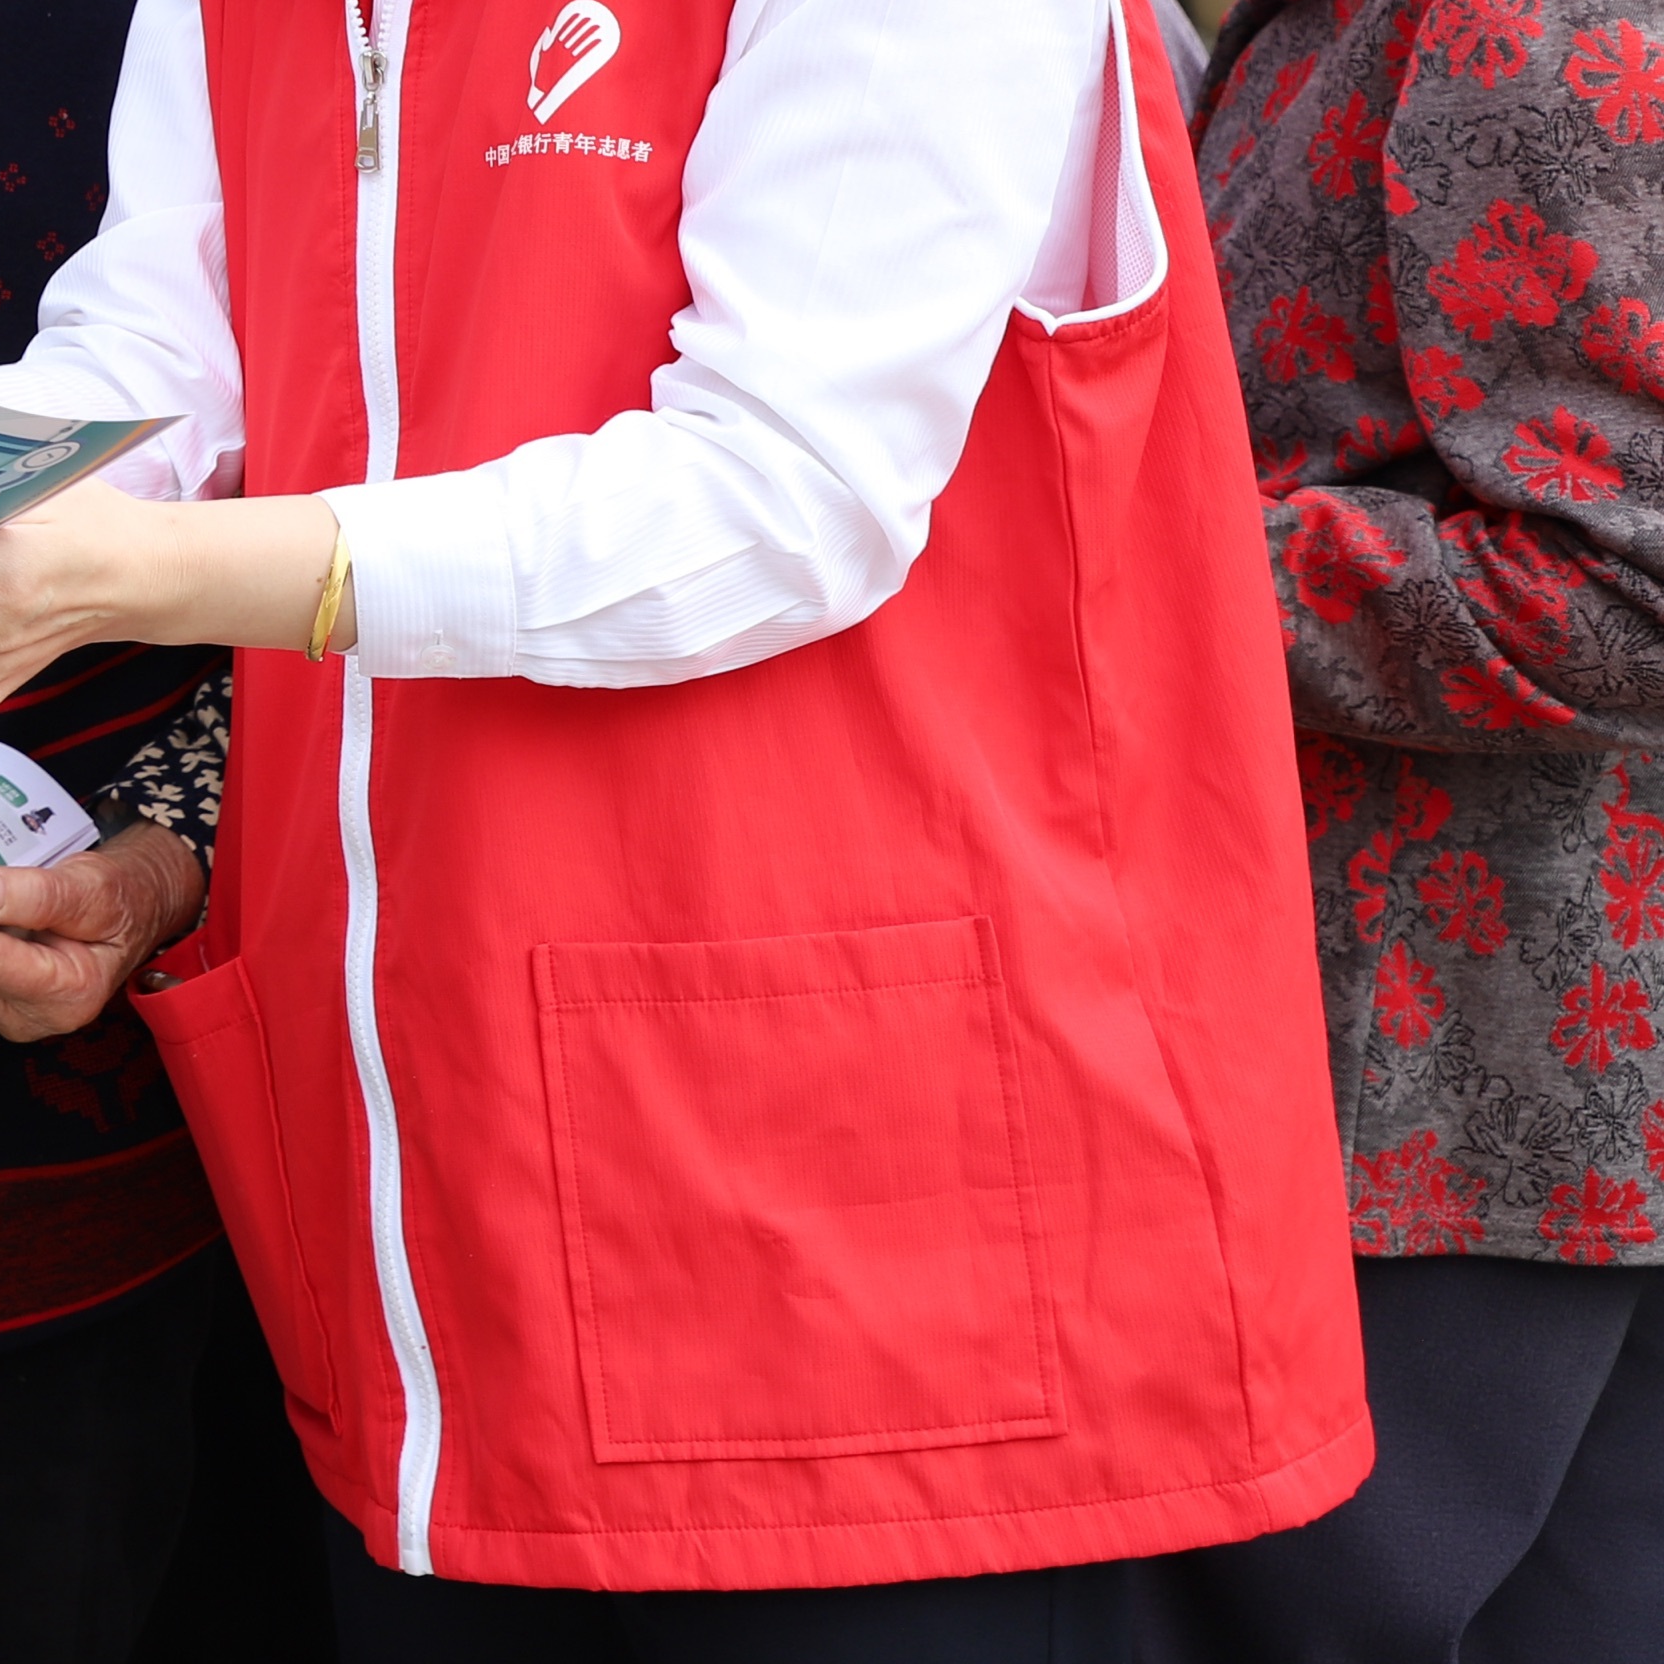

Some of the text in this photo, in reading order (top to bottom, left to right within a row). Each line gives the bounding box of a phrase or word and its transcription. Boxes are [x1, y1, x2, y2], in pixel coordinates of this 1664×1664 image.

[484, 131, 654, 168] 中国银行青年志愿者
